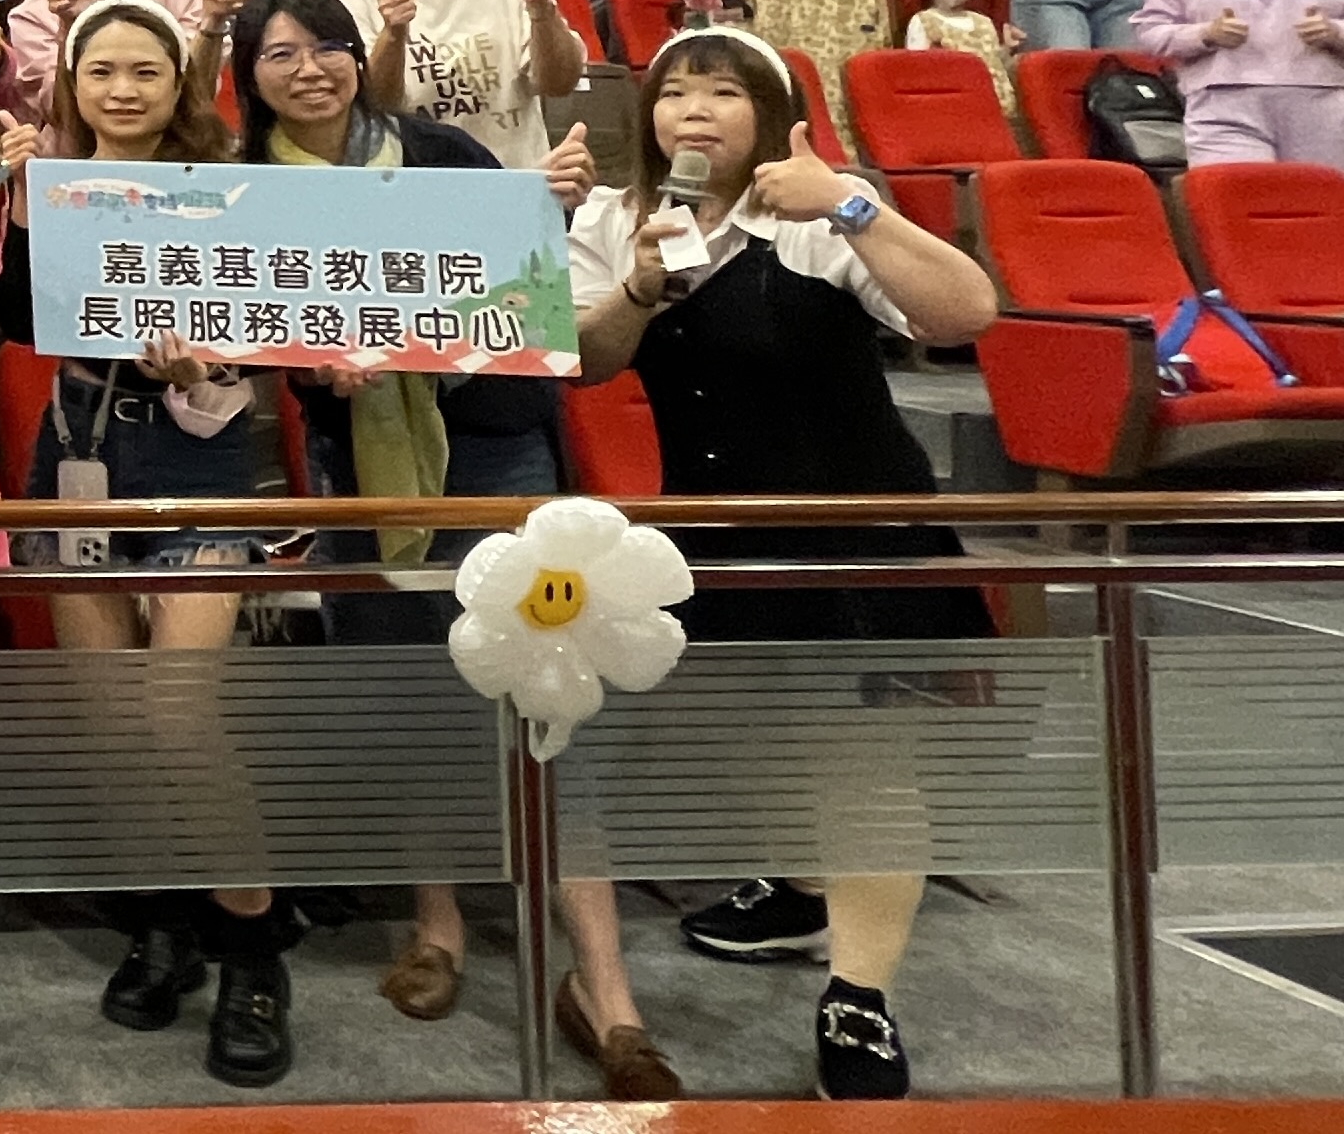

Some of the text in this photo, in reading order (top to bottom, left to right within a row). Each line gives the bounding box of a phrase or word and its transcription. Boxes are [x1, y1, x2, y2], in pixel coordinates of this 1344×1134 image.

[102, 242, 487, 296] 嘉義基督教醫院
[78, 296, 522, 352] 長照服務發展中心
